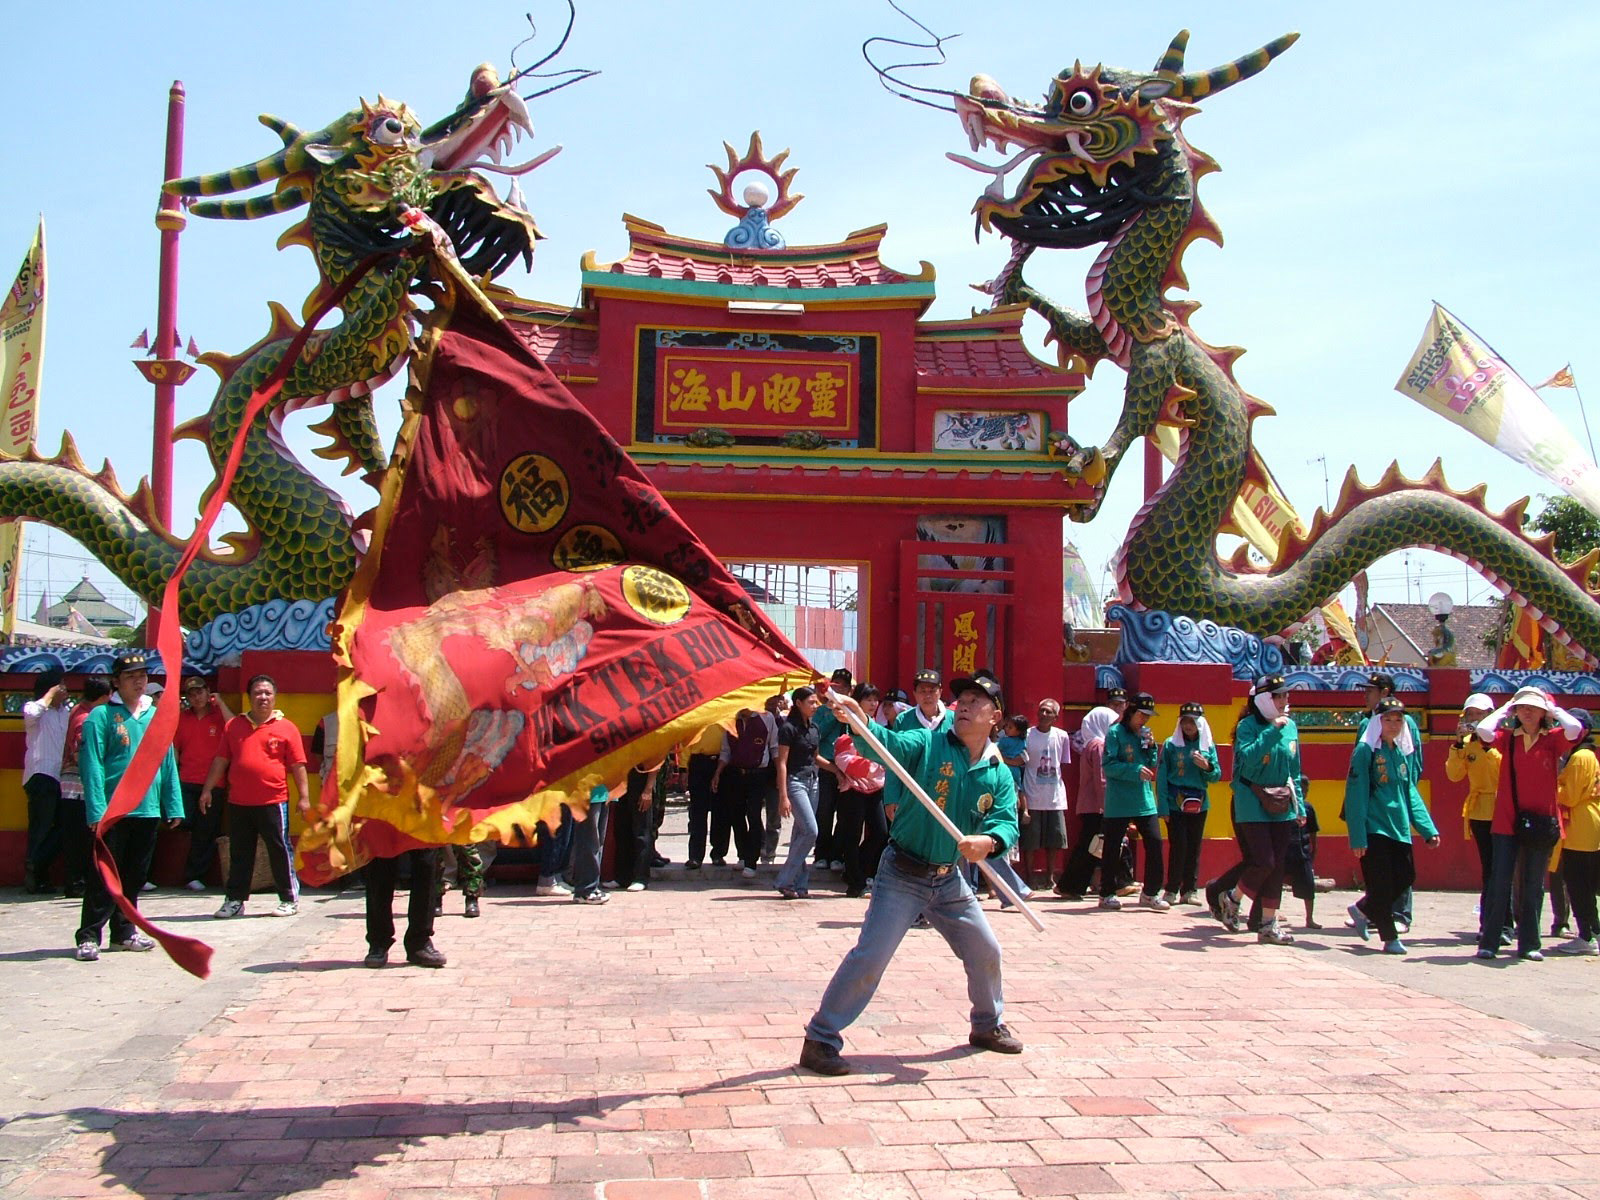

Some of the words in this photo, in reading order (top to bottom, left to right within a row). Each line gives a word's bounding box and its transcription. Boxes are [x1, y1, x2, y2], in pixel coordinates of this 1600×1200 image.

[505, 456, 565, 526] 福
[591, 636, 693, 712] TEK
[672, 619, 741, 671] BIO
[588, 677, 704, 754] SALATIGA
